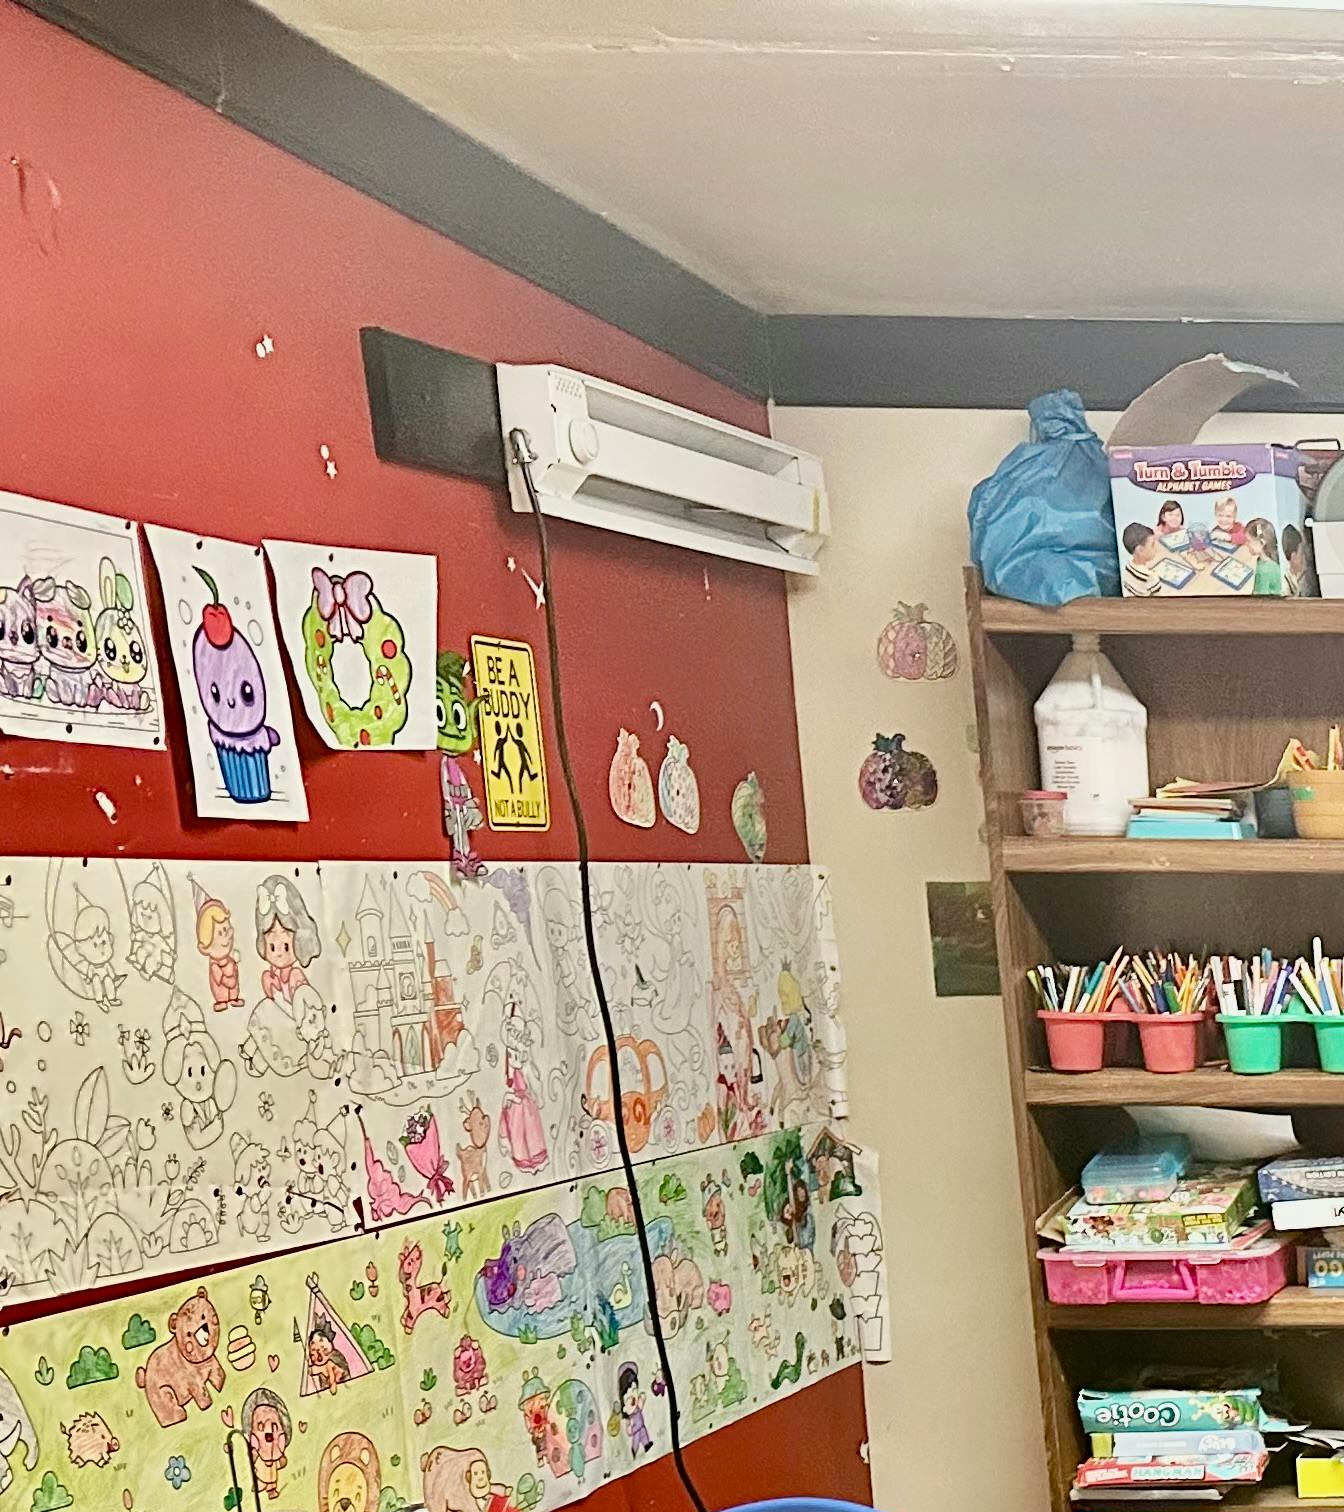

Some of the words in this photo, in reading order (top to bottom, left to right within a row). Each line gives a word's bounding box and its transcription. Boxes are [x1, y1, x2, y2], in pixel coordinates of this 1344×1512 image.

[1134, 461, 1170, 482] Turn
[1171, 462, 1188, 480] &
[1188, 460, 1247, 480] Tumble
[1156, 481, 1200, 493] ALPHABET
[1201, 480, 1233, 491] GAMES
[487, 656, 505, 685] BE
[509, 659, 520, 687] A
[483, 687, 531, 720] BUDDY
[494, 800, 509, 818] NOT
[511, 801, 517, 817] A
[517, 800, 541, 819] BULLY
[1094, 1401, 1181, 1428] Cootie
